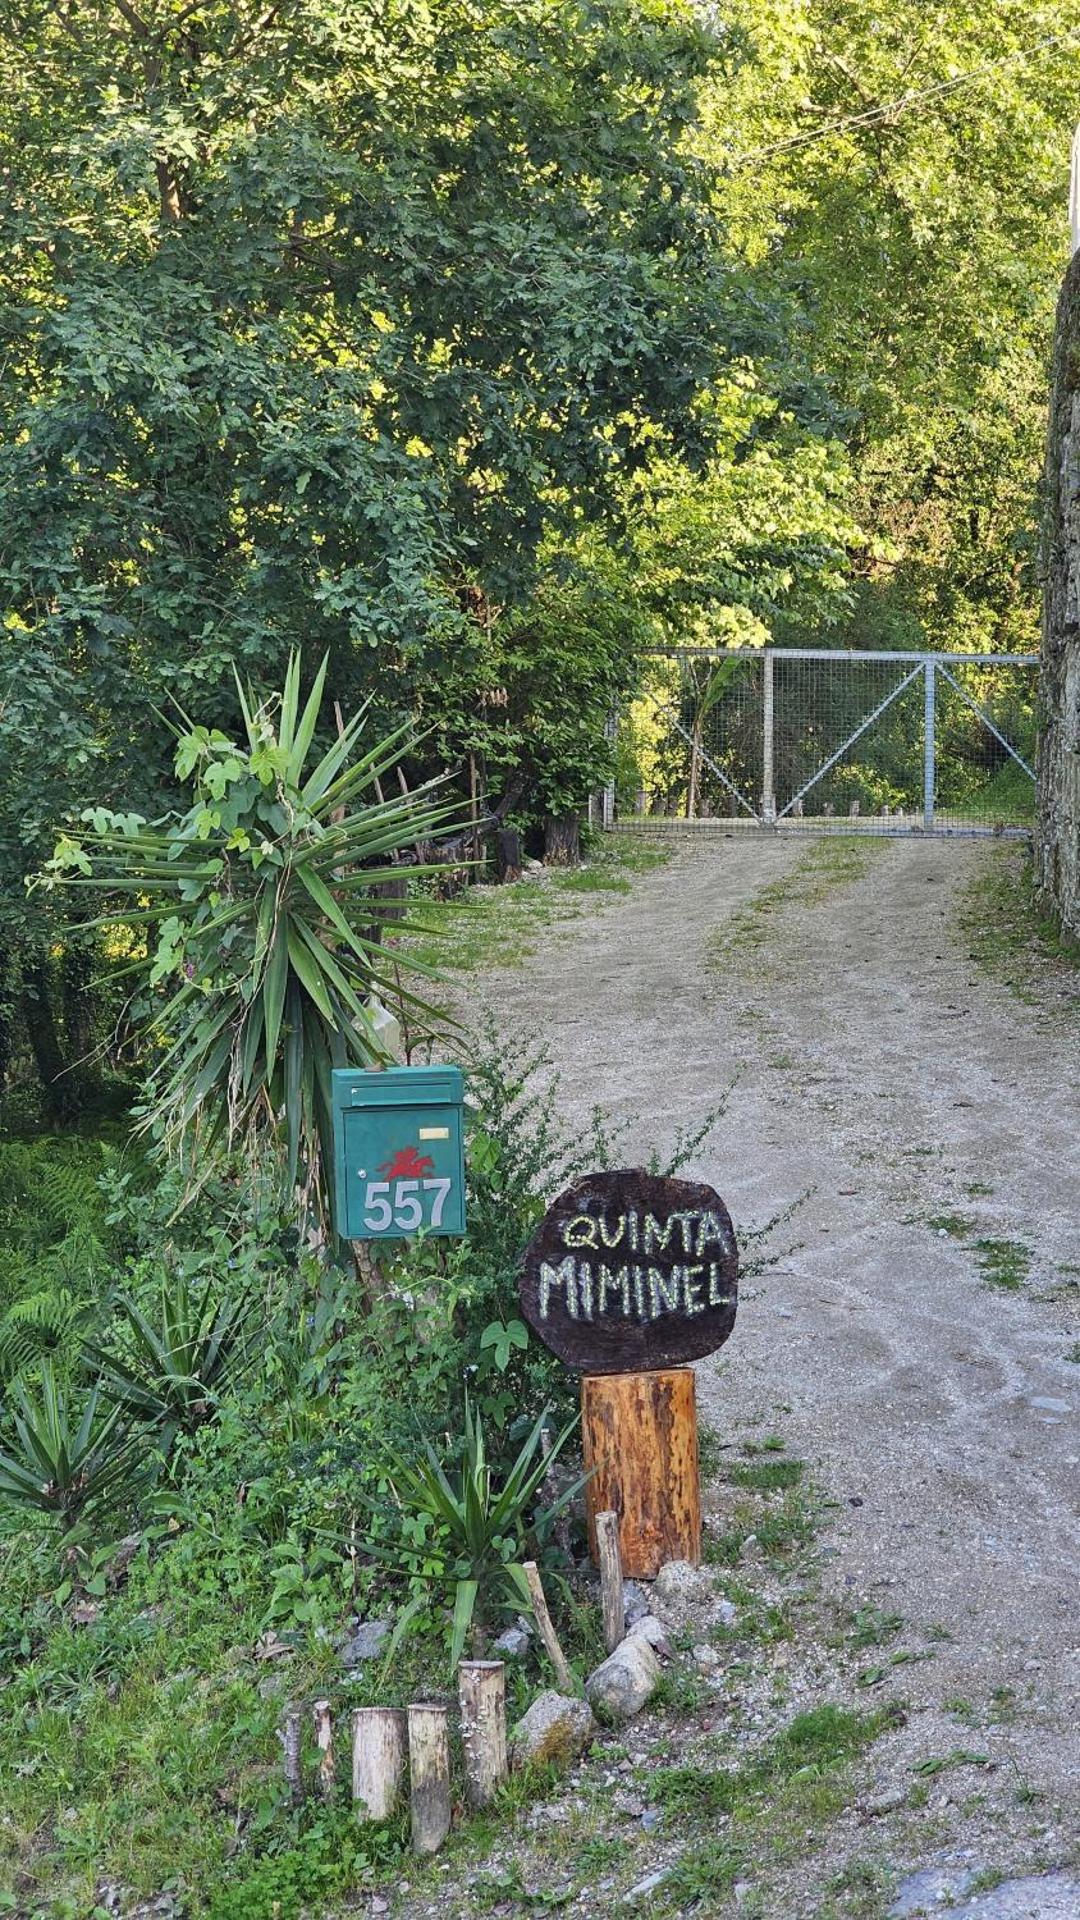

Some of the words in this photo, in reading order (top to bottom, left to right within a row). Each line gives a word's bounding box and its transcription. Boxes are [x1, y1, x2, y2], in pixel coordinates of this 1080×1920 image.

[363, 1178, 451, 1231] 557
[563, 1210, 729, 1256] QUINTA
[539, 1257, 730, 1320] MIMINEL
